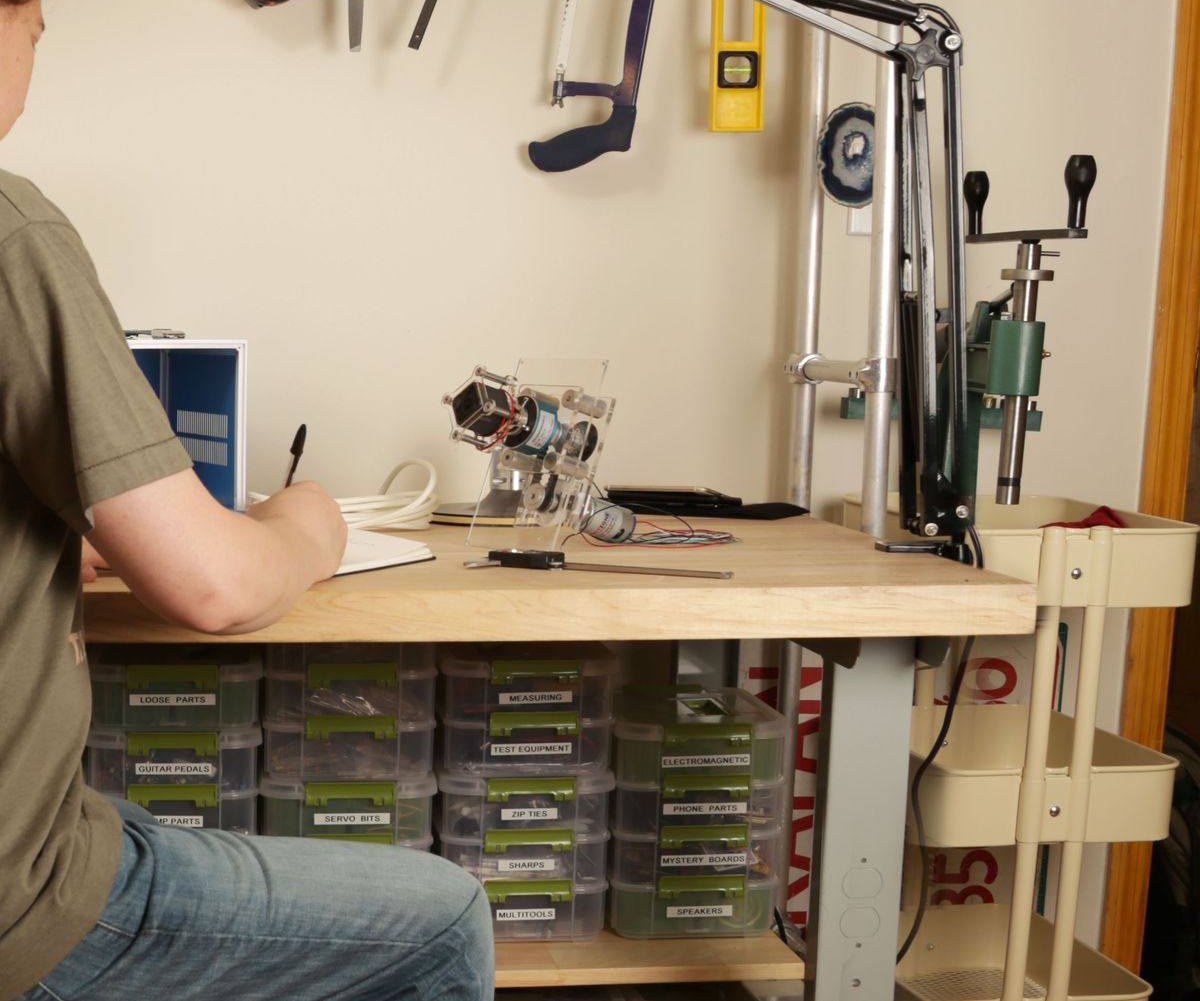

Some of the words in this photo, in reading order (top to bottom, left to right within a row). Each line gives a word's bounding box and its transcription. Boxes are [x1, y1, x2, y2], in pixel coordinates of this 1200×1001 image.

[139, 696, 171, 704] LOOSE
[175, 696, 206, 704] PARTS
[509, 693, 563, 702] MEASURING
[518, 744, 569, 753] EQUIPMENT
[663, 756, 749, 766] ELECTROMAGNETIC
[138, 765, 172, 773] GUITAR
[174, 765, 210, 773] PEDALS
[672, 805, 704, 813] PHONE
[708, 804, 738, 812] PARTS
[511, 810, 526, 818] ZIP
[529, 810, 548, 818] TIES
[324, 815, 356, 823] SERVO
[360, 815, 381, 823] BITS
[508, 861, 545, 869] SHARPS
[662, 856, 704, 865] MYSTERY
[498, 910, 553, 919] MULTITOOLS
[676, 907, 723, 916] SPEAKERS
